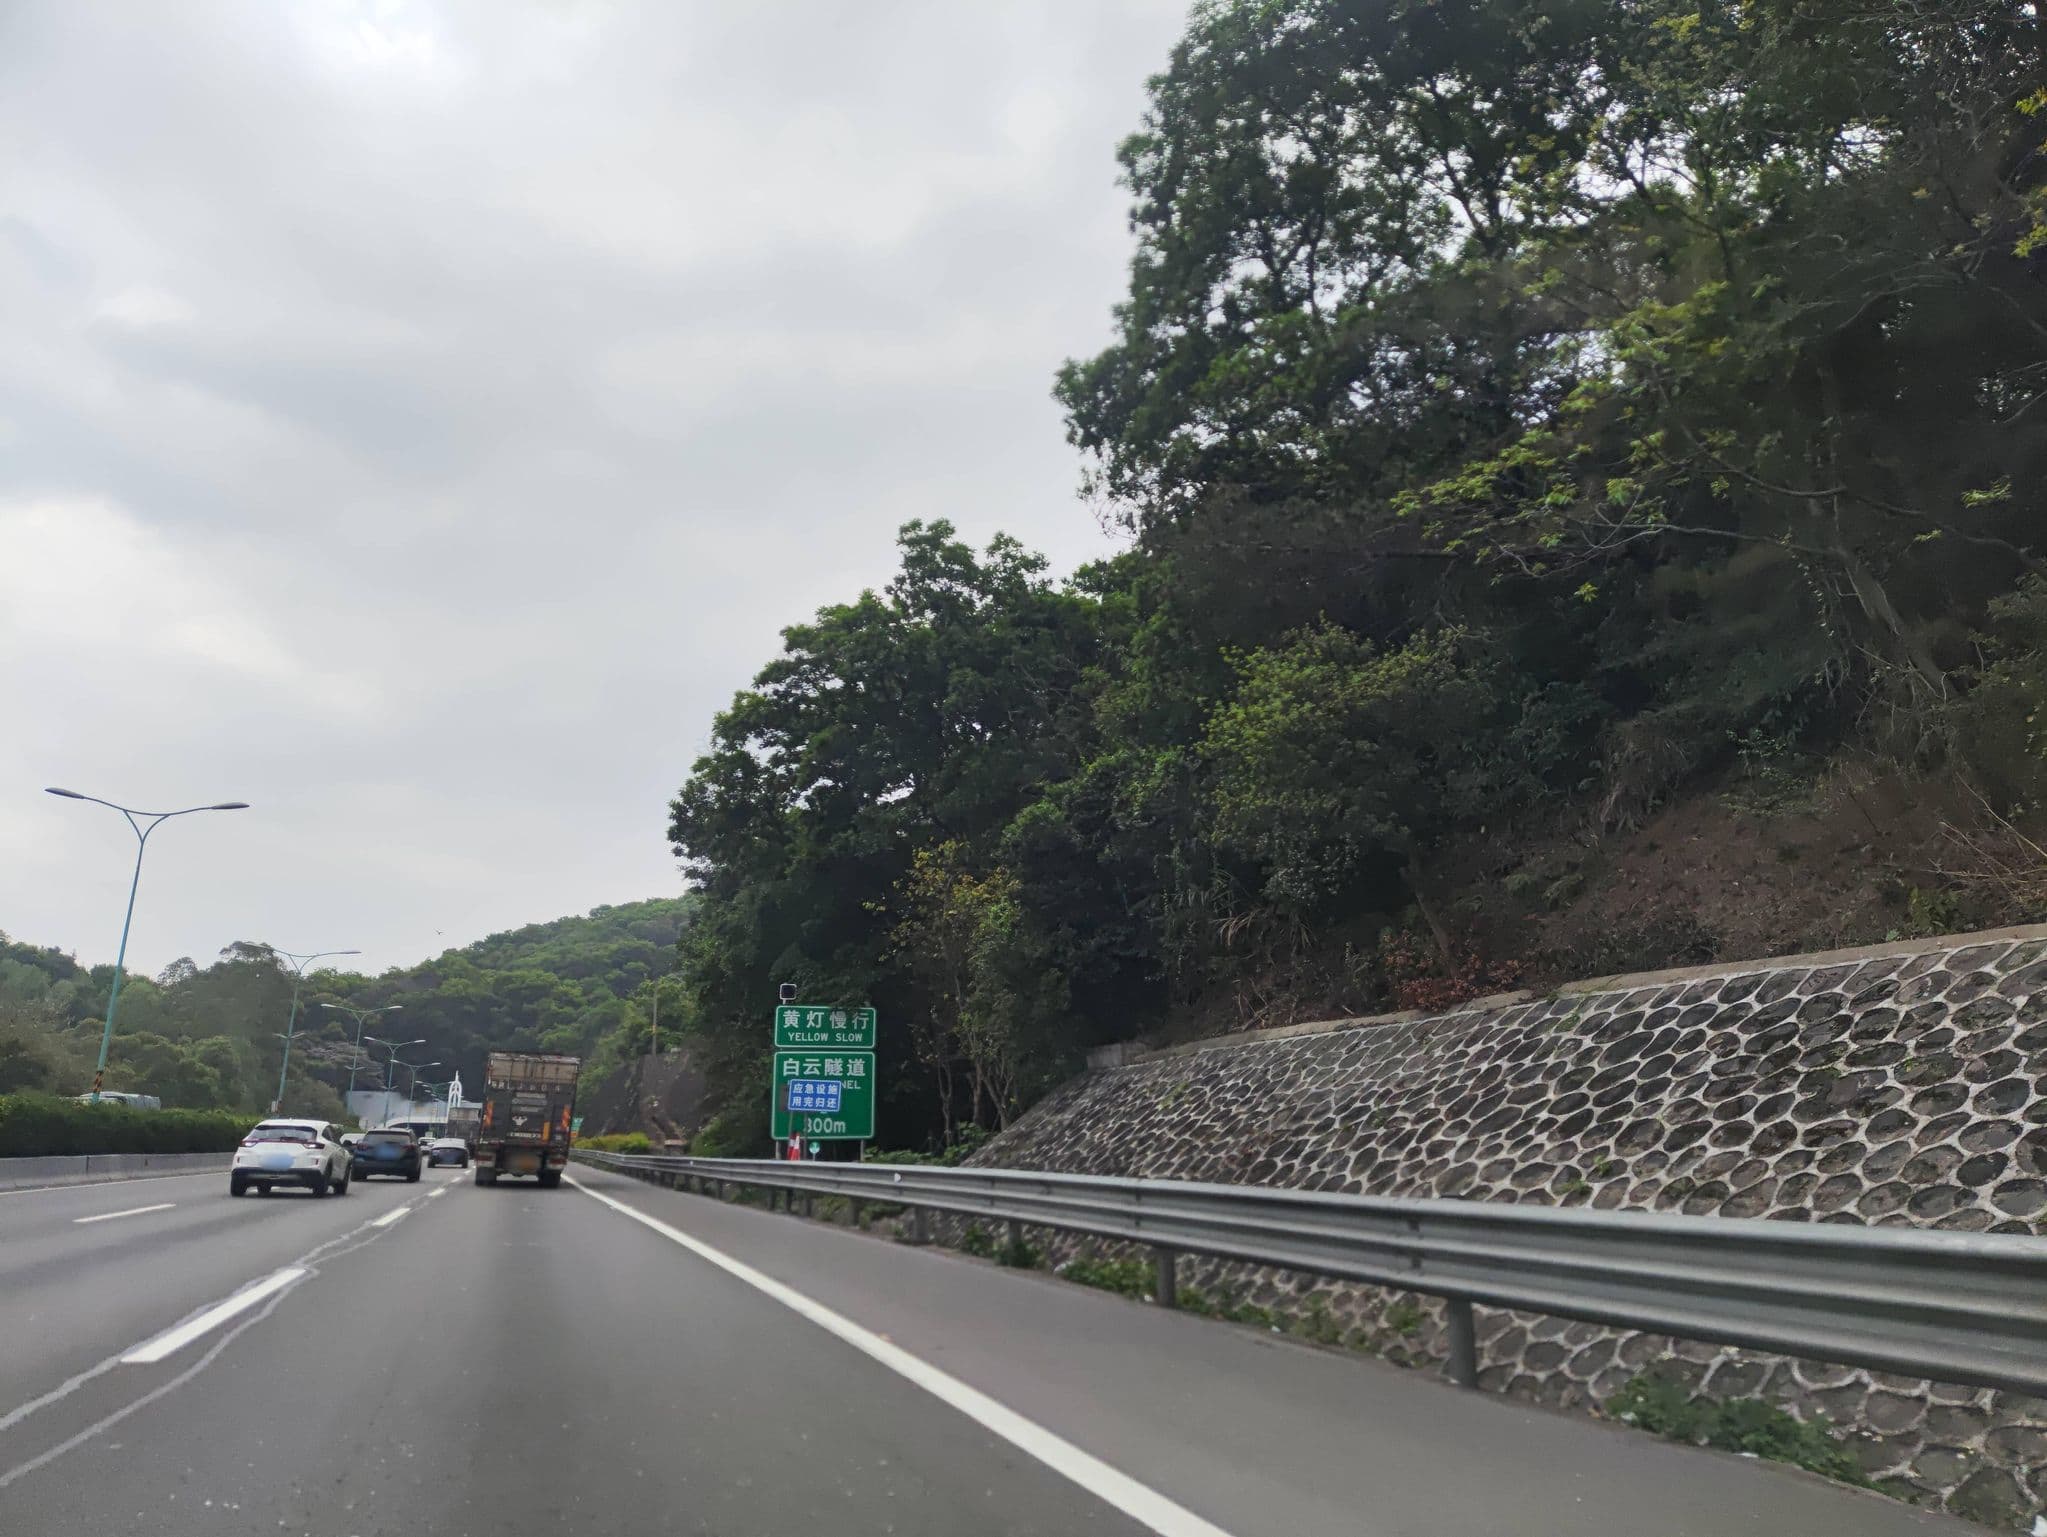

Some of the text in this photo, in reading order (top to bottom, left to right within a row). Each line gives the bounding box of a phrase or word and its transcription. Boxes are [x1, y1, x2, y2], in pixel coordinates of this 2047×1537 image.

[783, 1010, 869, 1029] 黄灯慢行
[788, 1032, 863, 1042] YELLOW SLOW
[783, 1058, 866, 1077] 白云隧道
[793, 1083, 838, 1095] 应急设施
[792, 1096, 837, 1108] 用完归还
